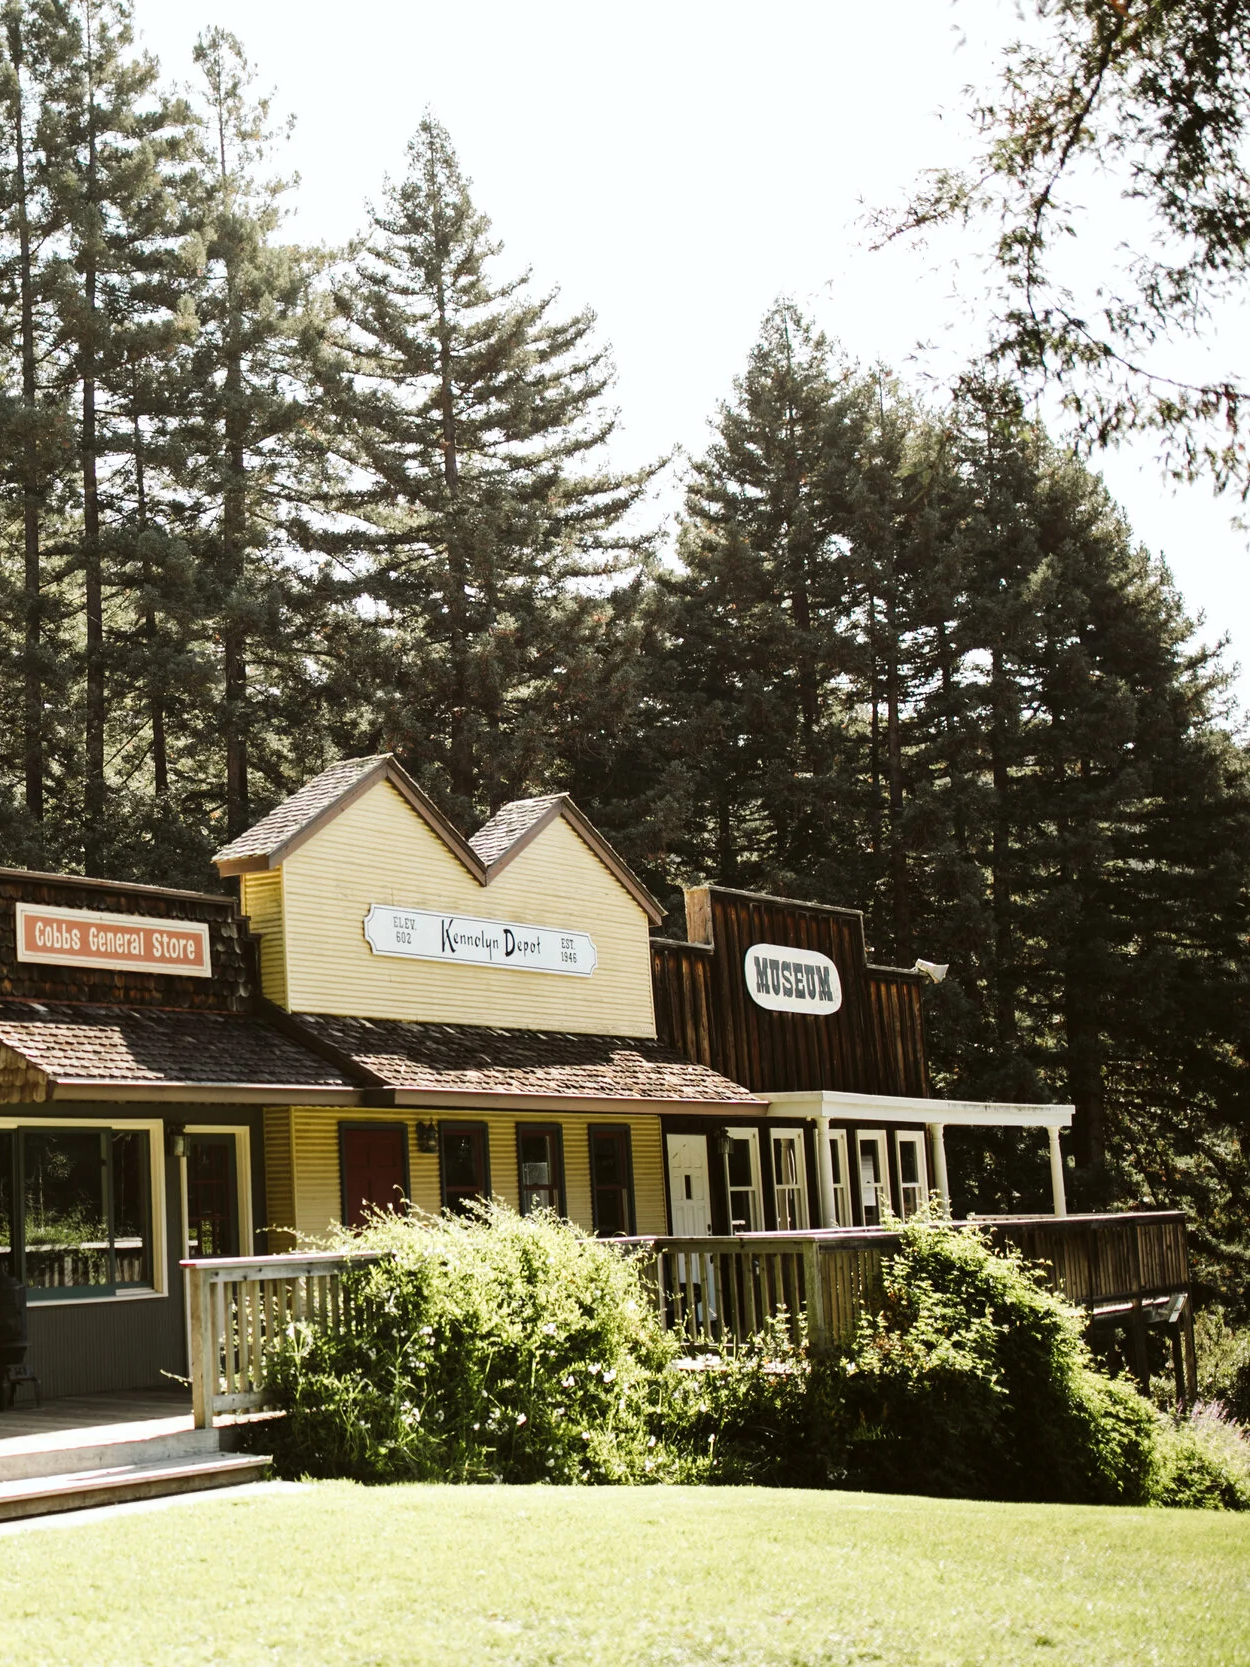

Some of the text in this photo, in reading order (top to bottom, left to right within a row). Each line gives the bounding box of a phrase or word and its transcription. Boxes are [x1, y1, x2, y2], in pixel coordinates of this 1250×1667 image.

[393, 916, 417, 930] ELEV.
[35, 921, 195, 960] Cobbs General Store
[396, 931, 412, 945] 602
[441, 918, 541, 960] Kennolyn Depot
[561, 938, 576, 950] EST.
[561, 951, 578, 963] 1946
[753, 956, 833, 1001] MUSEUM
